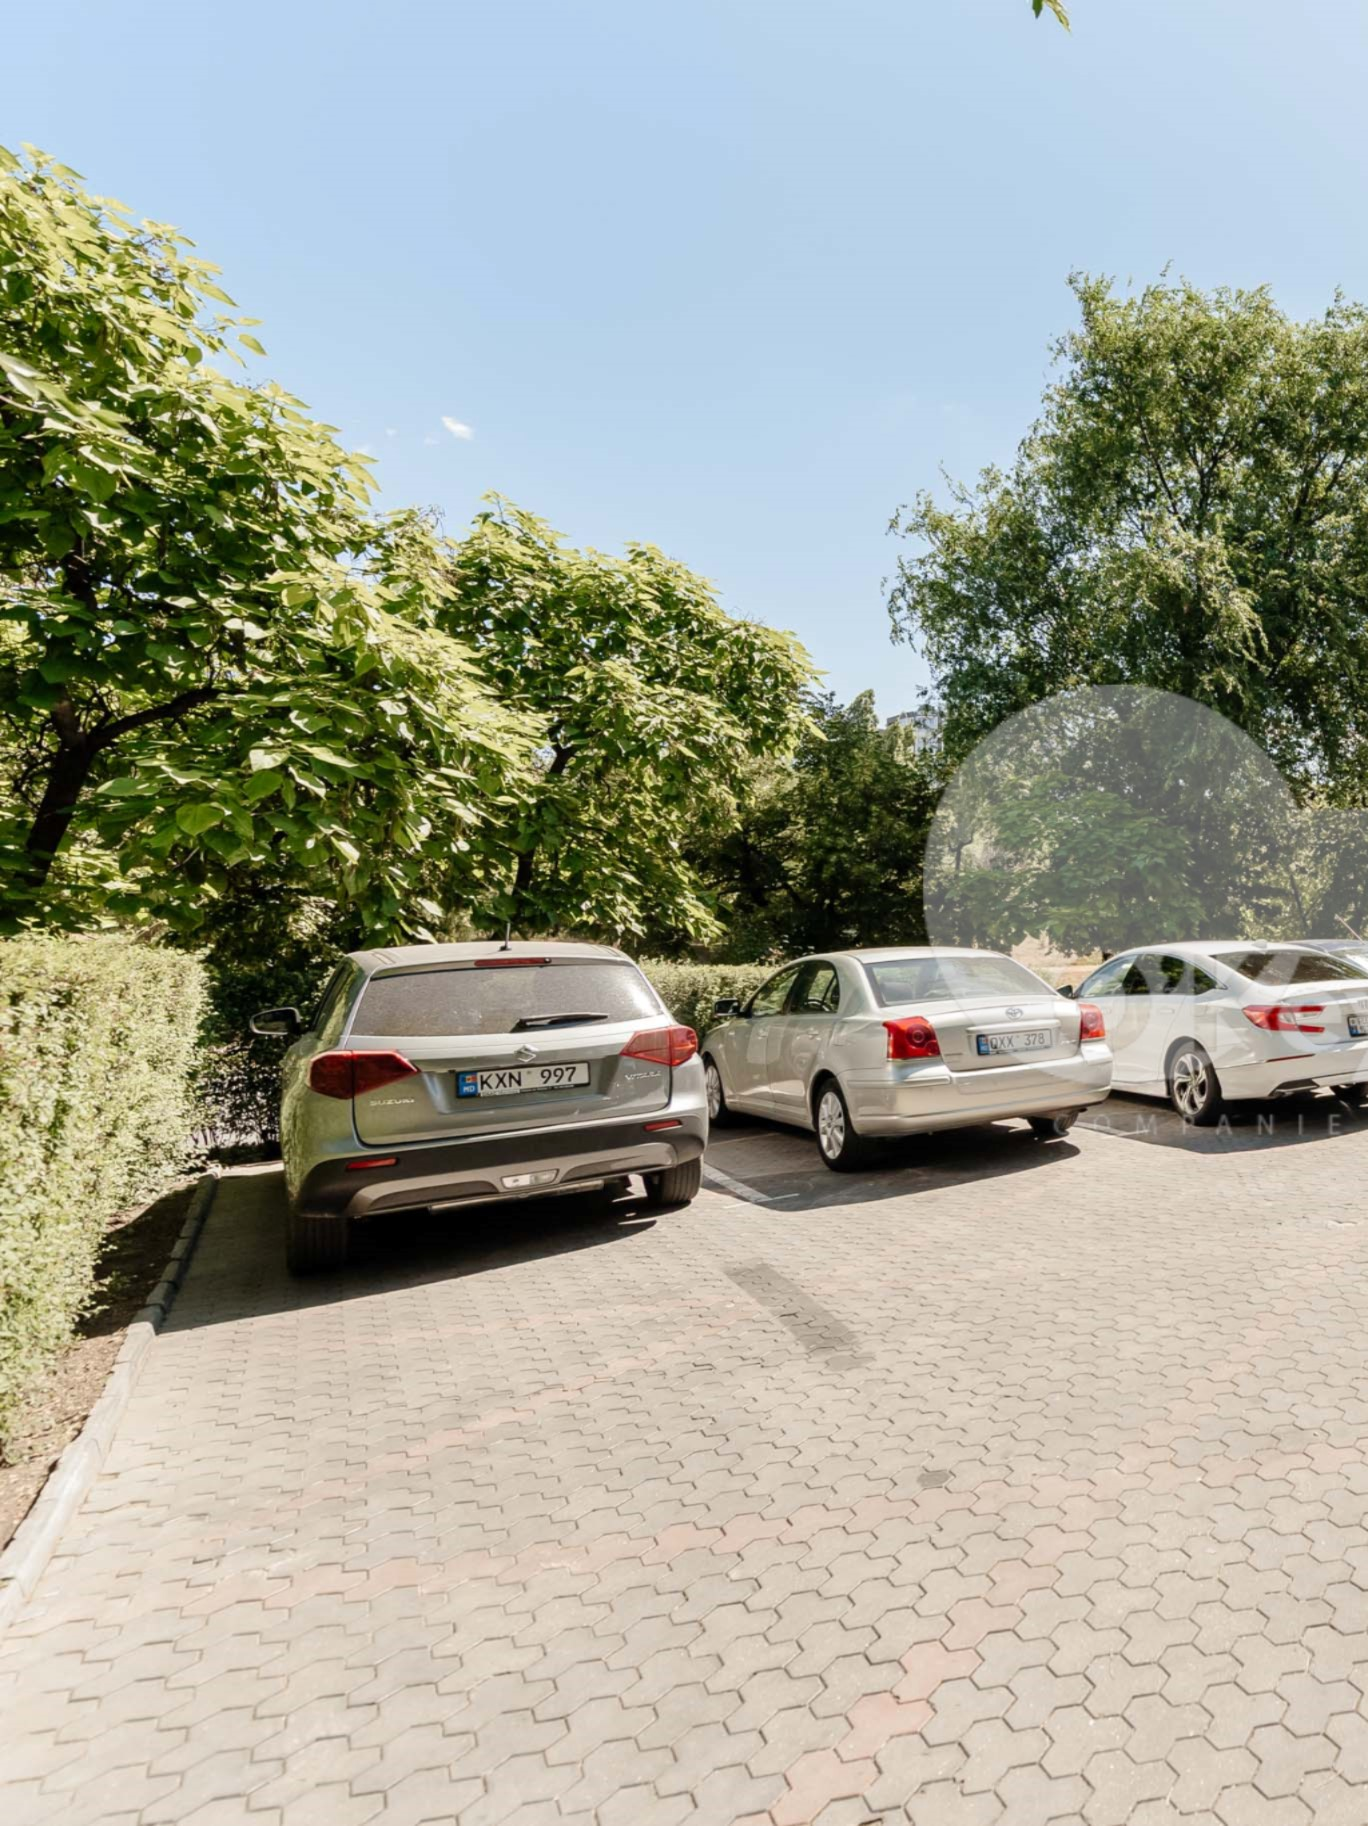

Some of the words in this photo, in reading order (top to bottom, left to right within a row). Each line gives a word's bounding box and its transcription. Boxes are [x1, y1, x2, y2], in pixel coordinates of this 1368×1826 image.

[989, 1035, 1015, 1050] QXX
[1024, 1032, 1046, 1046] 378
[480, 1071, 522, 1091] KXN
[540, 1066, 577, 1085] 997
